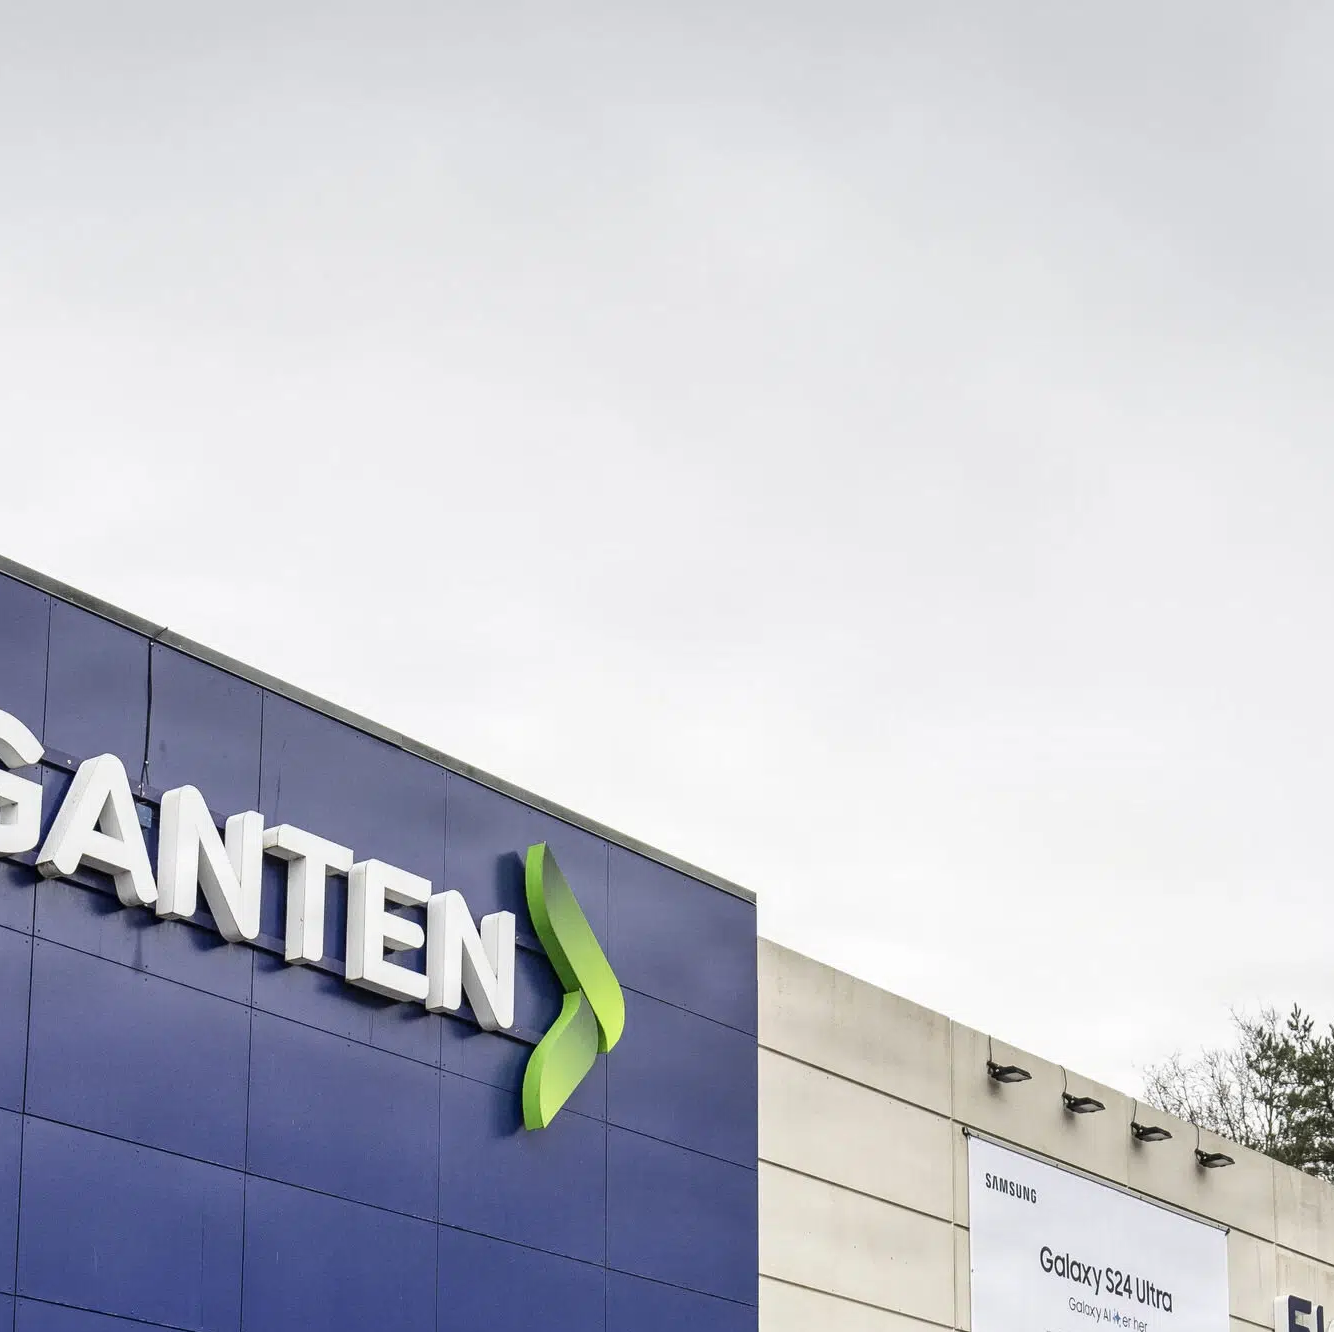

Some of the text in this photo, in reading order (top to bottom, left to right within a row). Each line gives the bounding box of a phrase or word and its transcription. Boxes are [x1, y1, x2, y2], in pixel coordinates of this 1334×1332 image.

[985, 1172, 1037, 1204] SAMSUNG
[1040, 1246, 1173, 1312] Galaxy S24 Ultra
[1068, 1297, 1102, 1323] Galaxy
[1122, 1316, 1132, 1328] er
[1133, 1315, 1148, 1332] her
